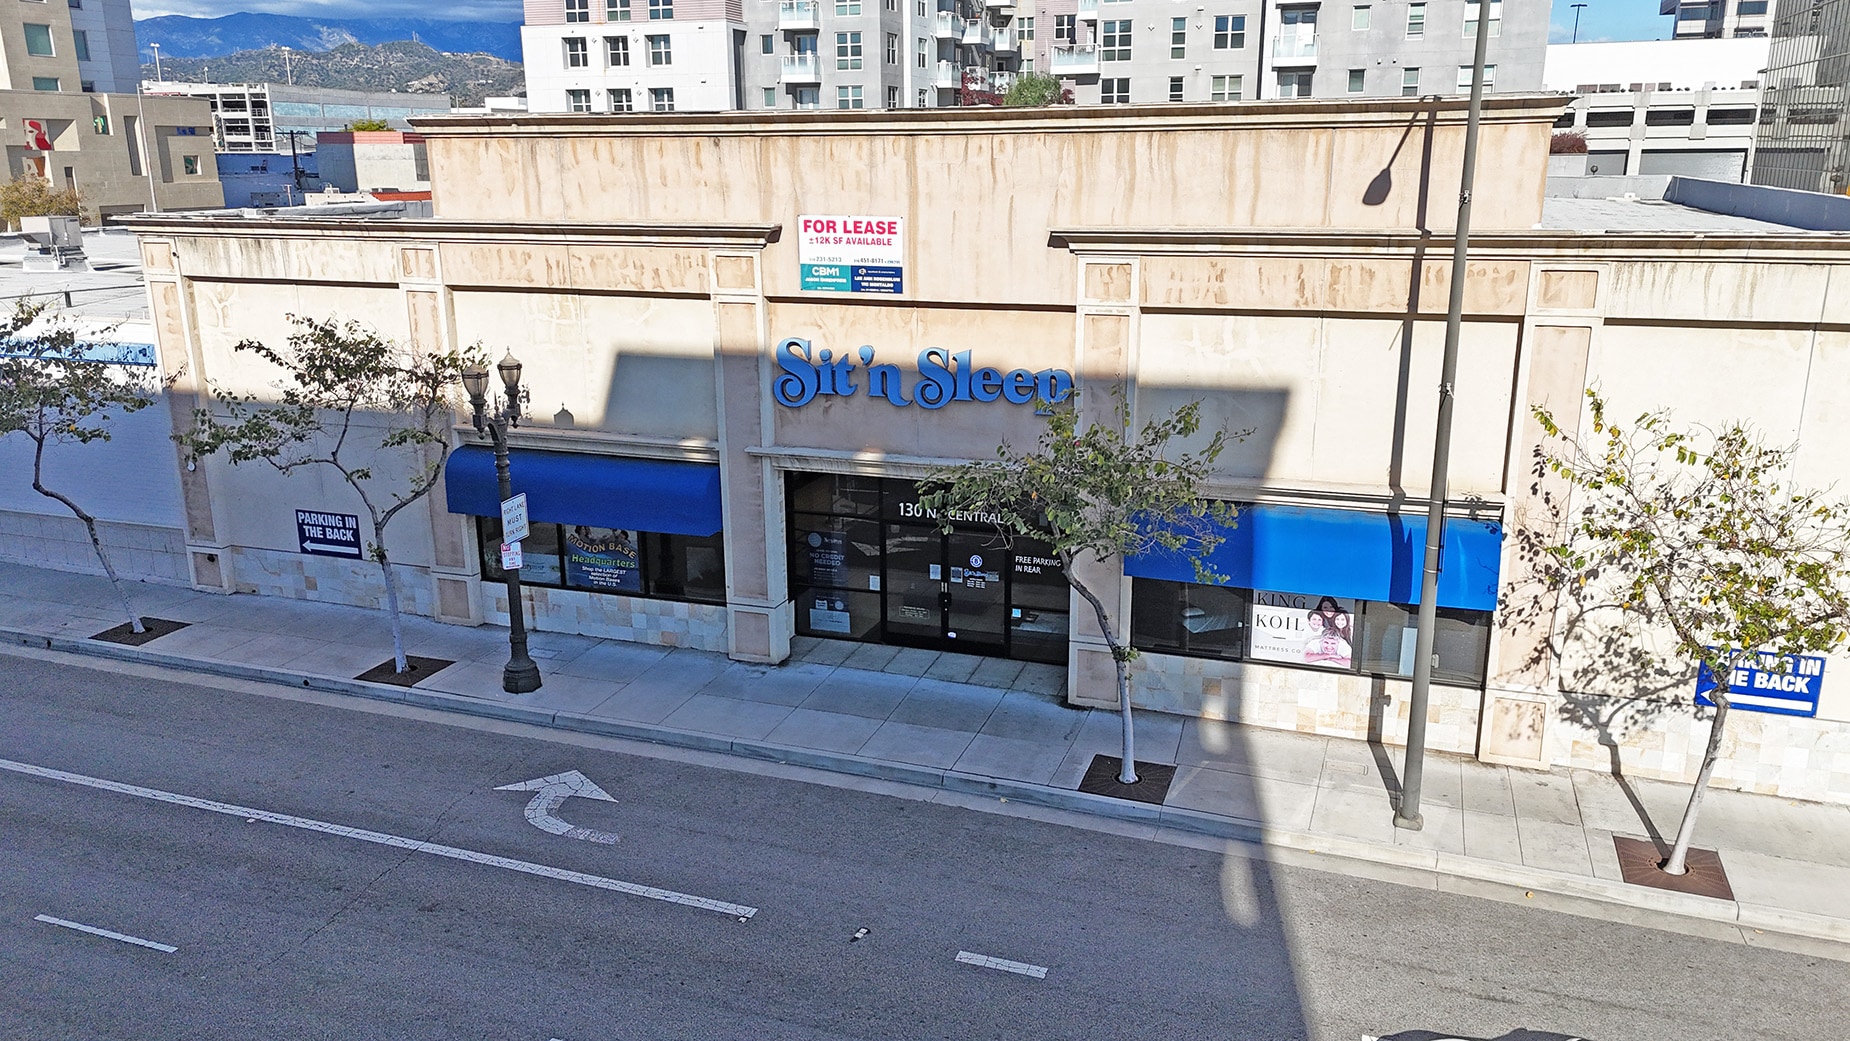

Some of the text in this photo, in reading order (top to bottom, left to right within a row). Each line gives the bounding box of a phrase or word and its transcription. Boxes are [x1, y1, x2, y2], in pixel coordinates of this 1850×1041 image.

[803, 219, 898, 235] FOR LEASE
[833, 236, 844, 245] SF
[845, 237, 893, 246] AVAILABLE
[811, 266, 840, 277] CBM1
[914, 347, 1075, 416] Sleep
[297, 511, 357, 529] PARKING IN
[507, 513, 522, 527] MUST
[899, 502, 923, 518] 130
[948, 509, 1005, 524] CENTRAL
[303, 525, 355, 542] THE BACK
[568, 533, 637, 559] MOTION BASE
[571, 554, 636, 569] Headquarters
[820, 553, 845, 561] CREDIT
[1015, 555, 1061, 567] FREE PARKING
[1015, 564, 1042, 574] IN REAR
[1257, 592, 1306, 609] KING
[1256, 613, 1305, 631] KOIL
[1254, 644, 1289, 653] MATTRESS
[1798, 656, 1822, 677] IN
[1753, 672, 1811, 694] BACK
